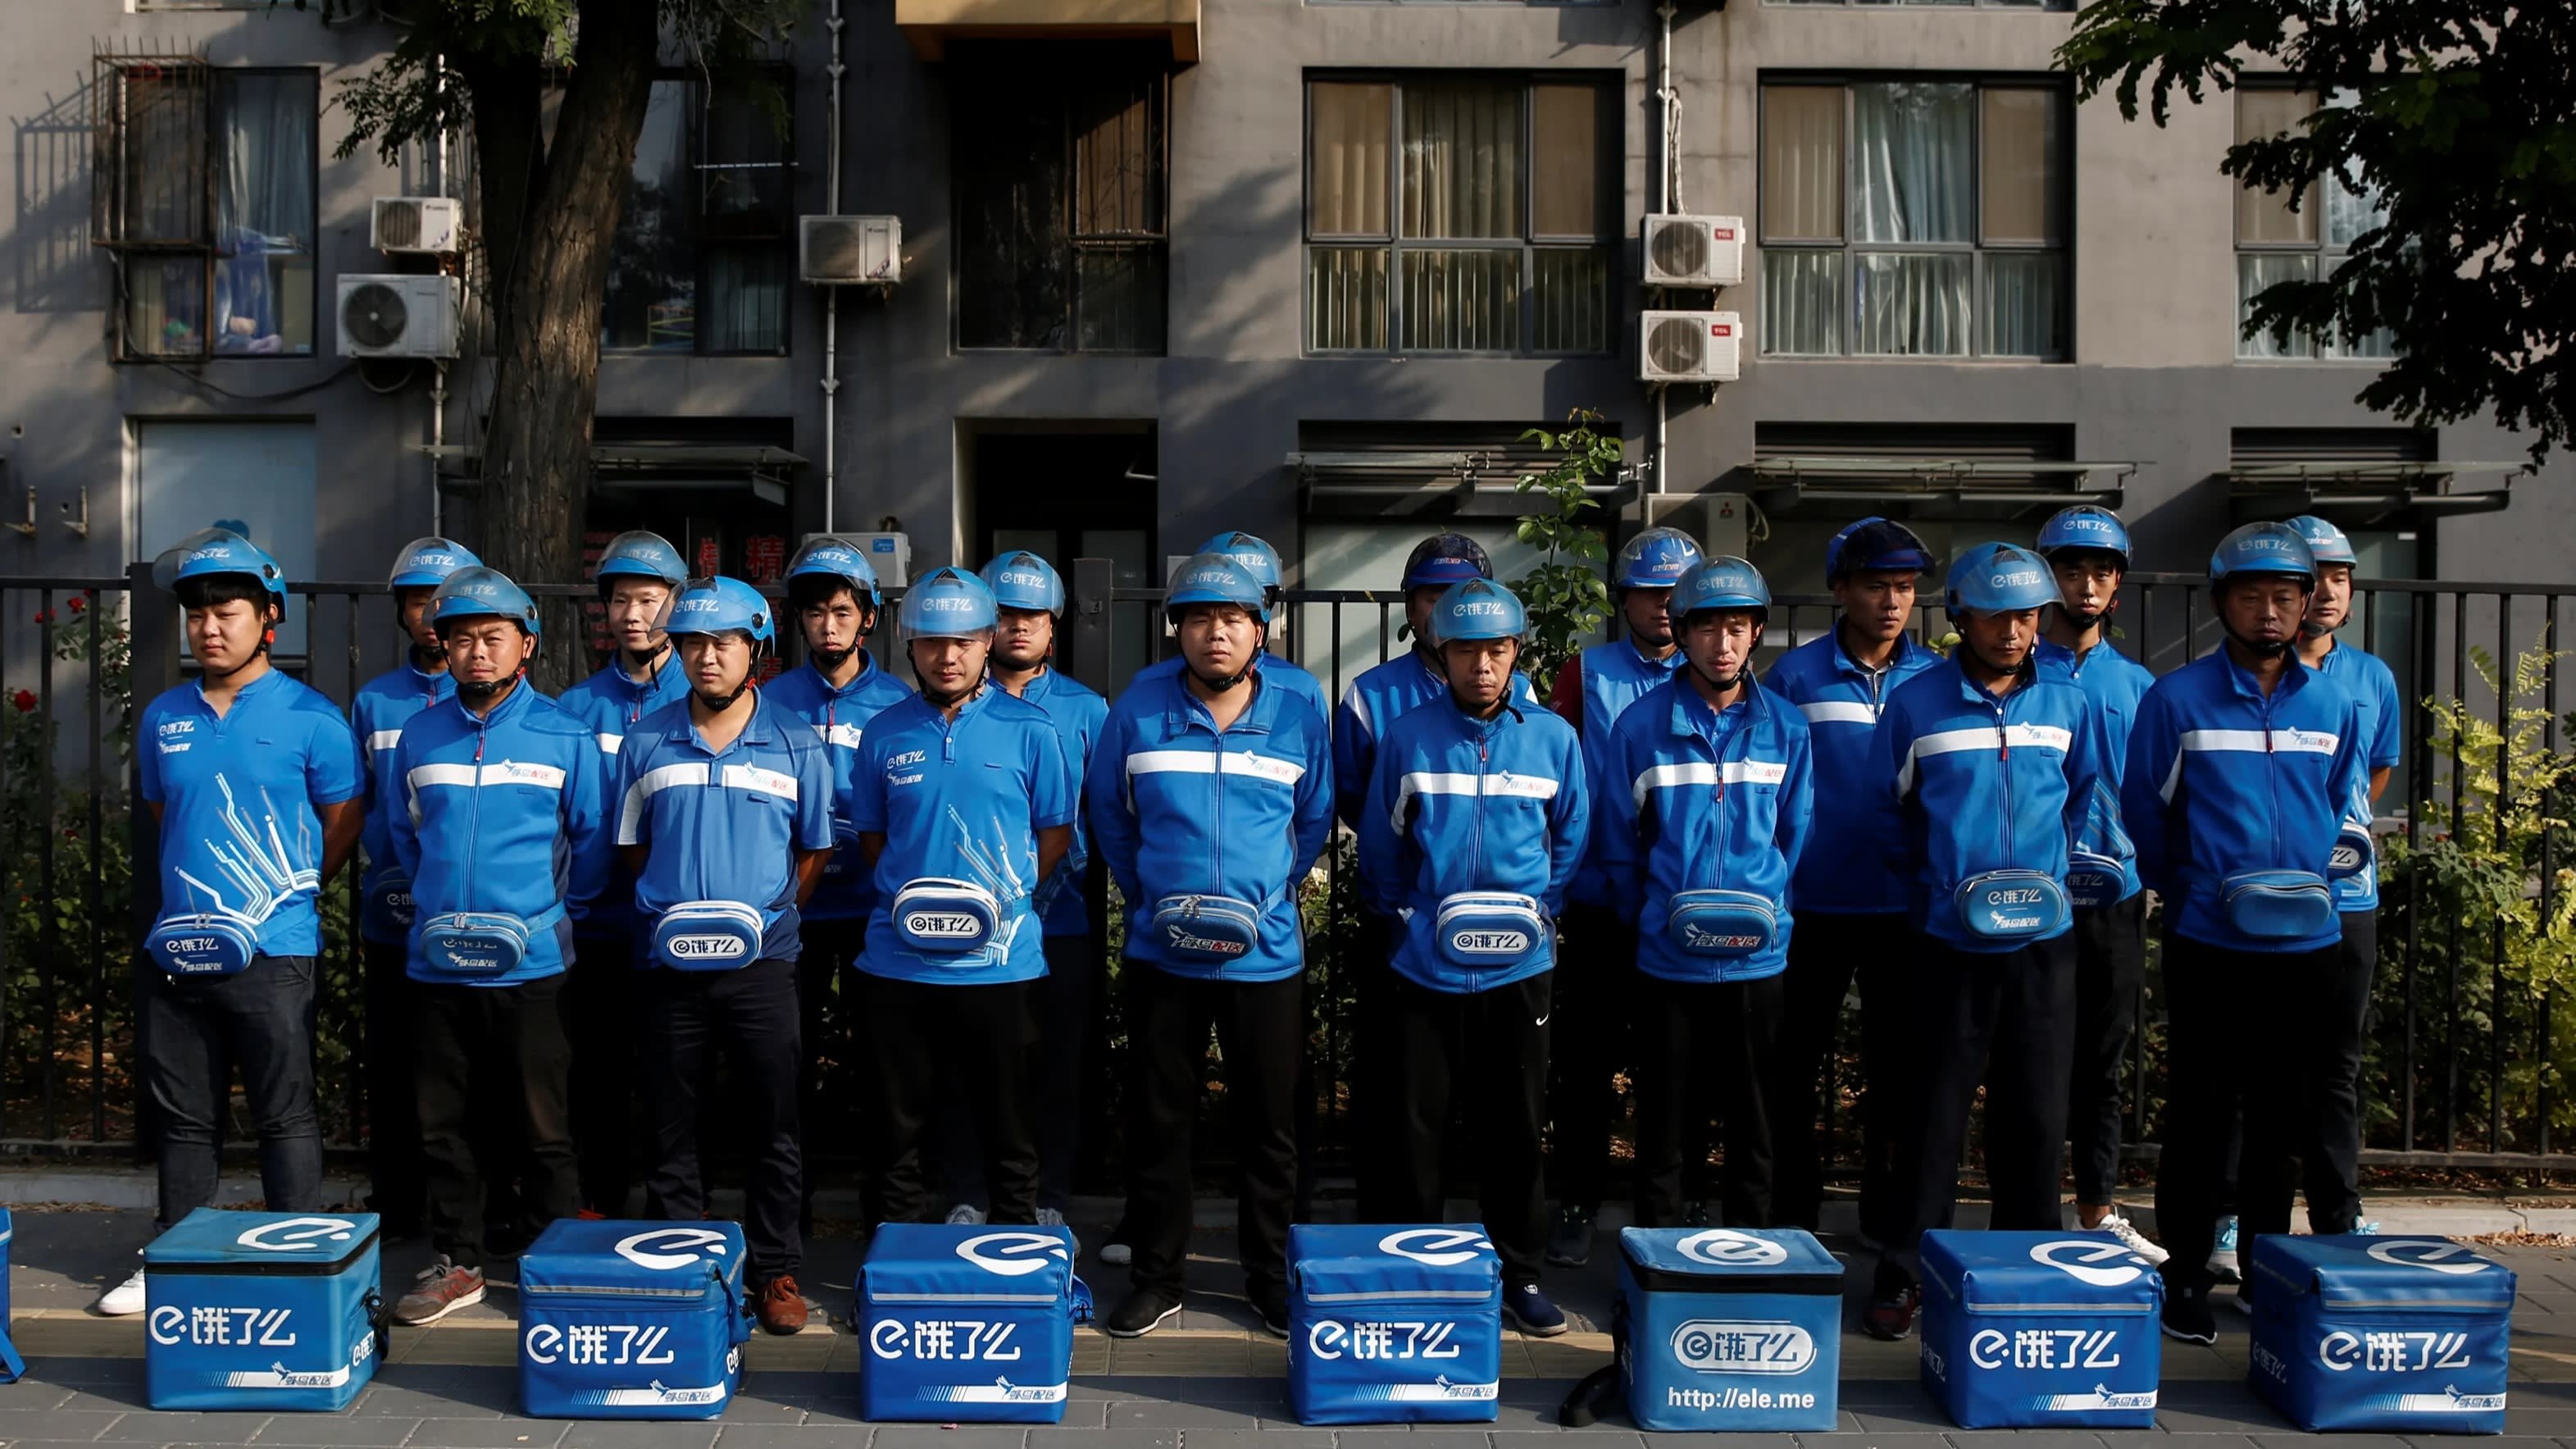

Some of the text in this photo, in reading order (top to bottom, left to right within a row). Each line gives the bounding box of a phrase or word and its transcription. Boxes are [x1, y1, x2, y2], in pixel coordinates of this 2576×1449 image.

[149, 1305, 296, 1346] e饿了么
[525, 1324, 675, 1365] e饿了么
[870, 1319, 1021, 1360] e饿了么
[1308, 1319, 1460, 1360] e饿了么
[1968, 1328, 2120, 1369] e饿了么
[2319, 1331, 2471, 1372] e饿了么
[1668, 1386, 1814, 1410] http://ele.me
